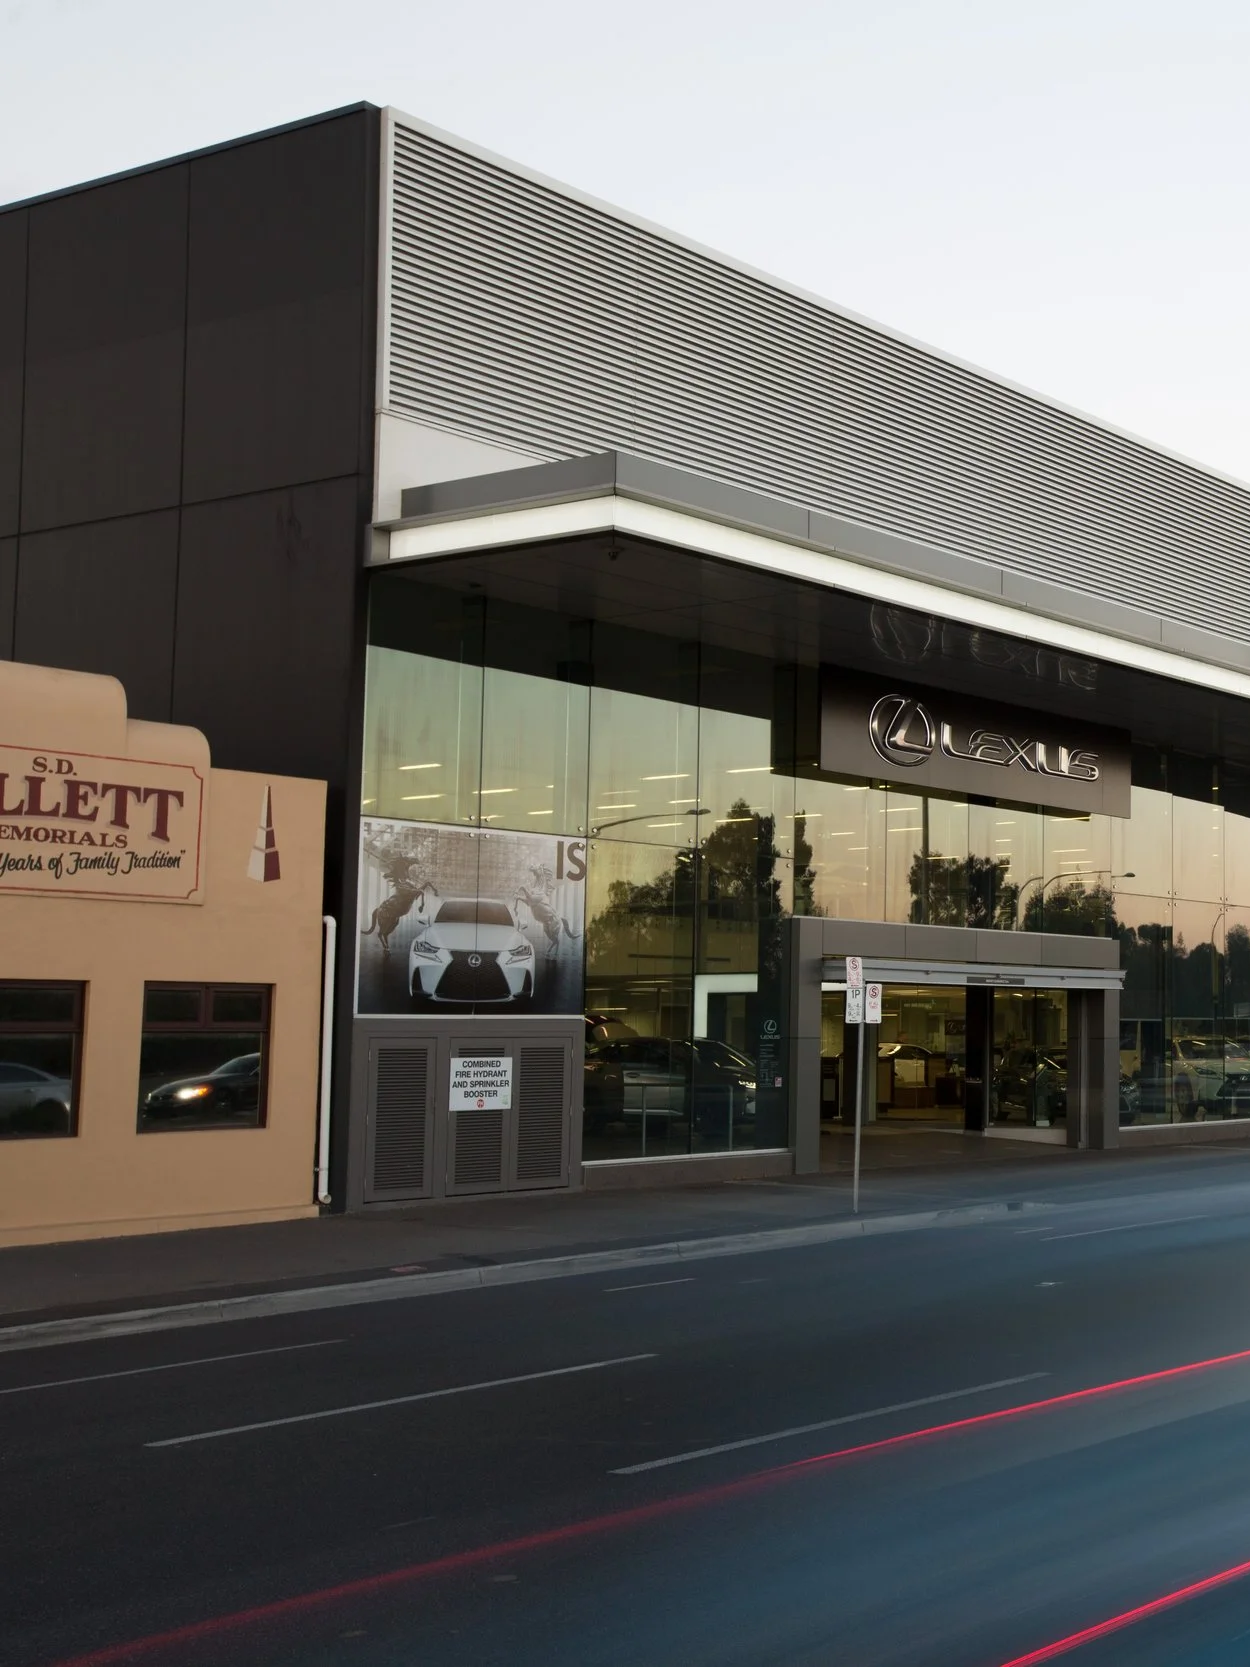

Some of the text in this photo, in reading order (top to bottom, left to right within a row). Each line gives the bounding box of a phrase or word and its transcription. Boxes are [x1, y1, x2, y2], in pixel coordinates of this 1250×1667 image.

[940, 720, 1101, 782] LEXUS
[32, 756, 78, 776] S.D.
[48, 852, 64, 879] of
[66, 851, 121, 876] Family
[556, 841, 587, 881] IS
[851, 989, 861, 999] 1P
[462, 1060, 502, 1068] COMBINED
[455, 1069, 508, 1078] FIRE HYDRANT
[452, 1079, 510, 1088] AND SPRINKLER
[463, 1090, 498, 1098] BOOSTER
